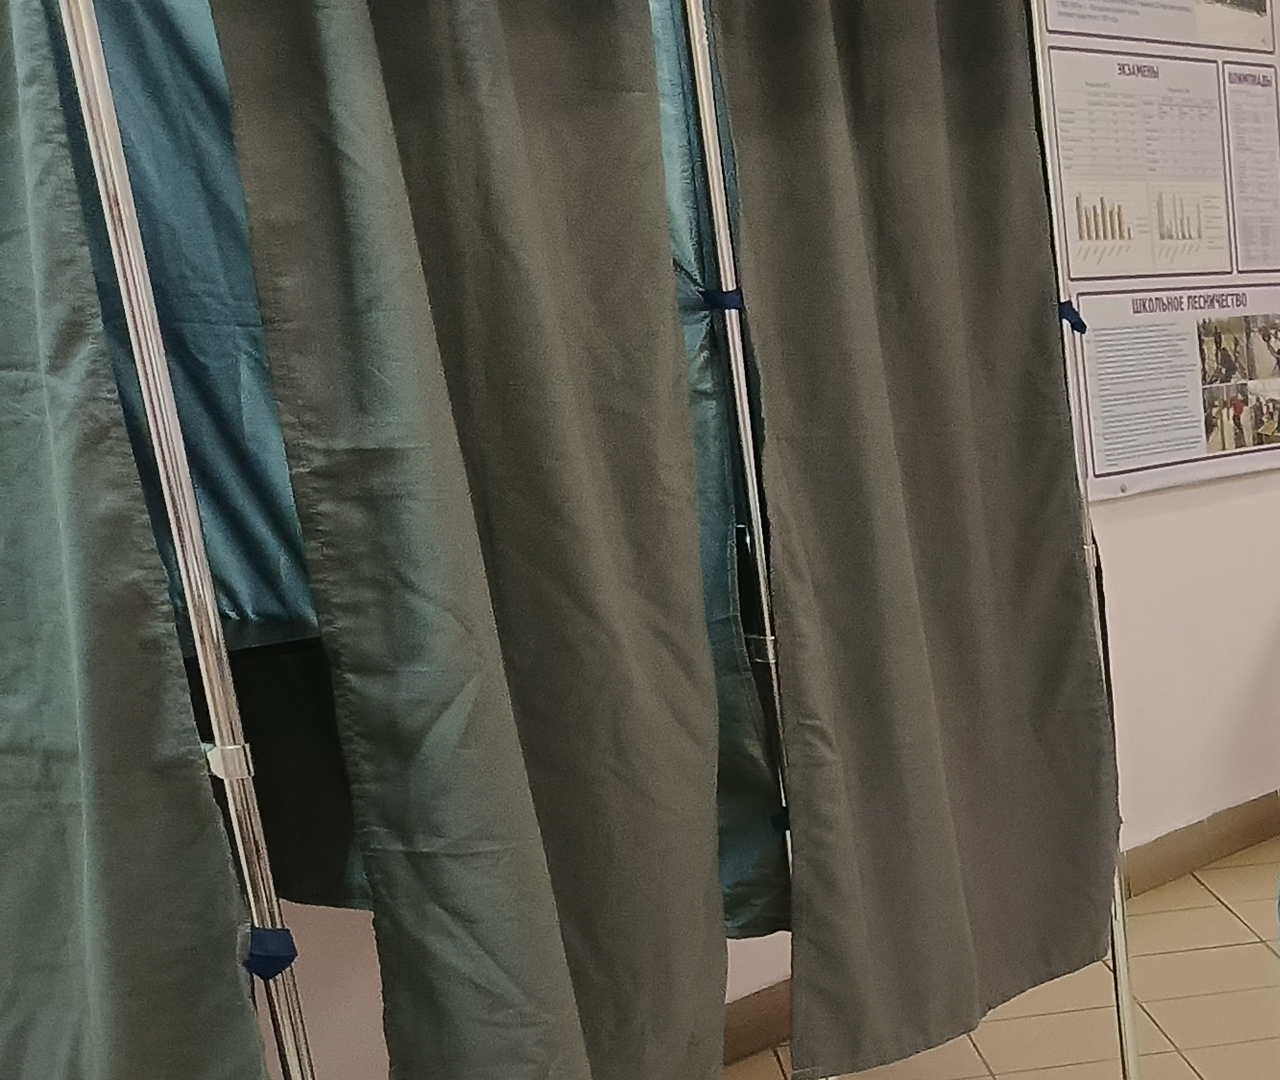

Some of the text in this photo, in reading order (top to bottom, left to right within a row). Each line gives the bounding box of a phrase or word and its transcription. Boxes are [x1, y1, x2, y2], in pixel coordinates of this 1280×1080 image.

[1117, 63, 1159, 79] ЭКЗАМЕНЫ
[1132, 292, 1247, 314] ШКОЛЬНОЕ ЛЕСНИЧЕСТВО
